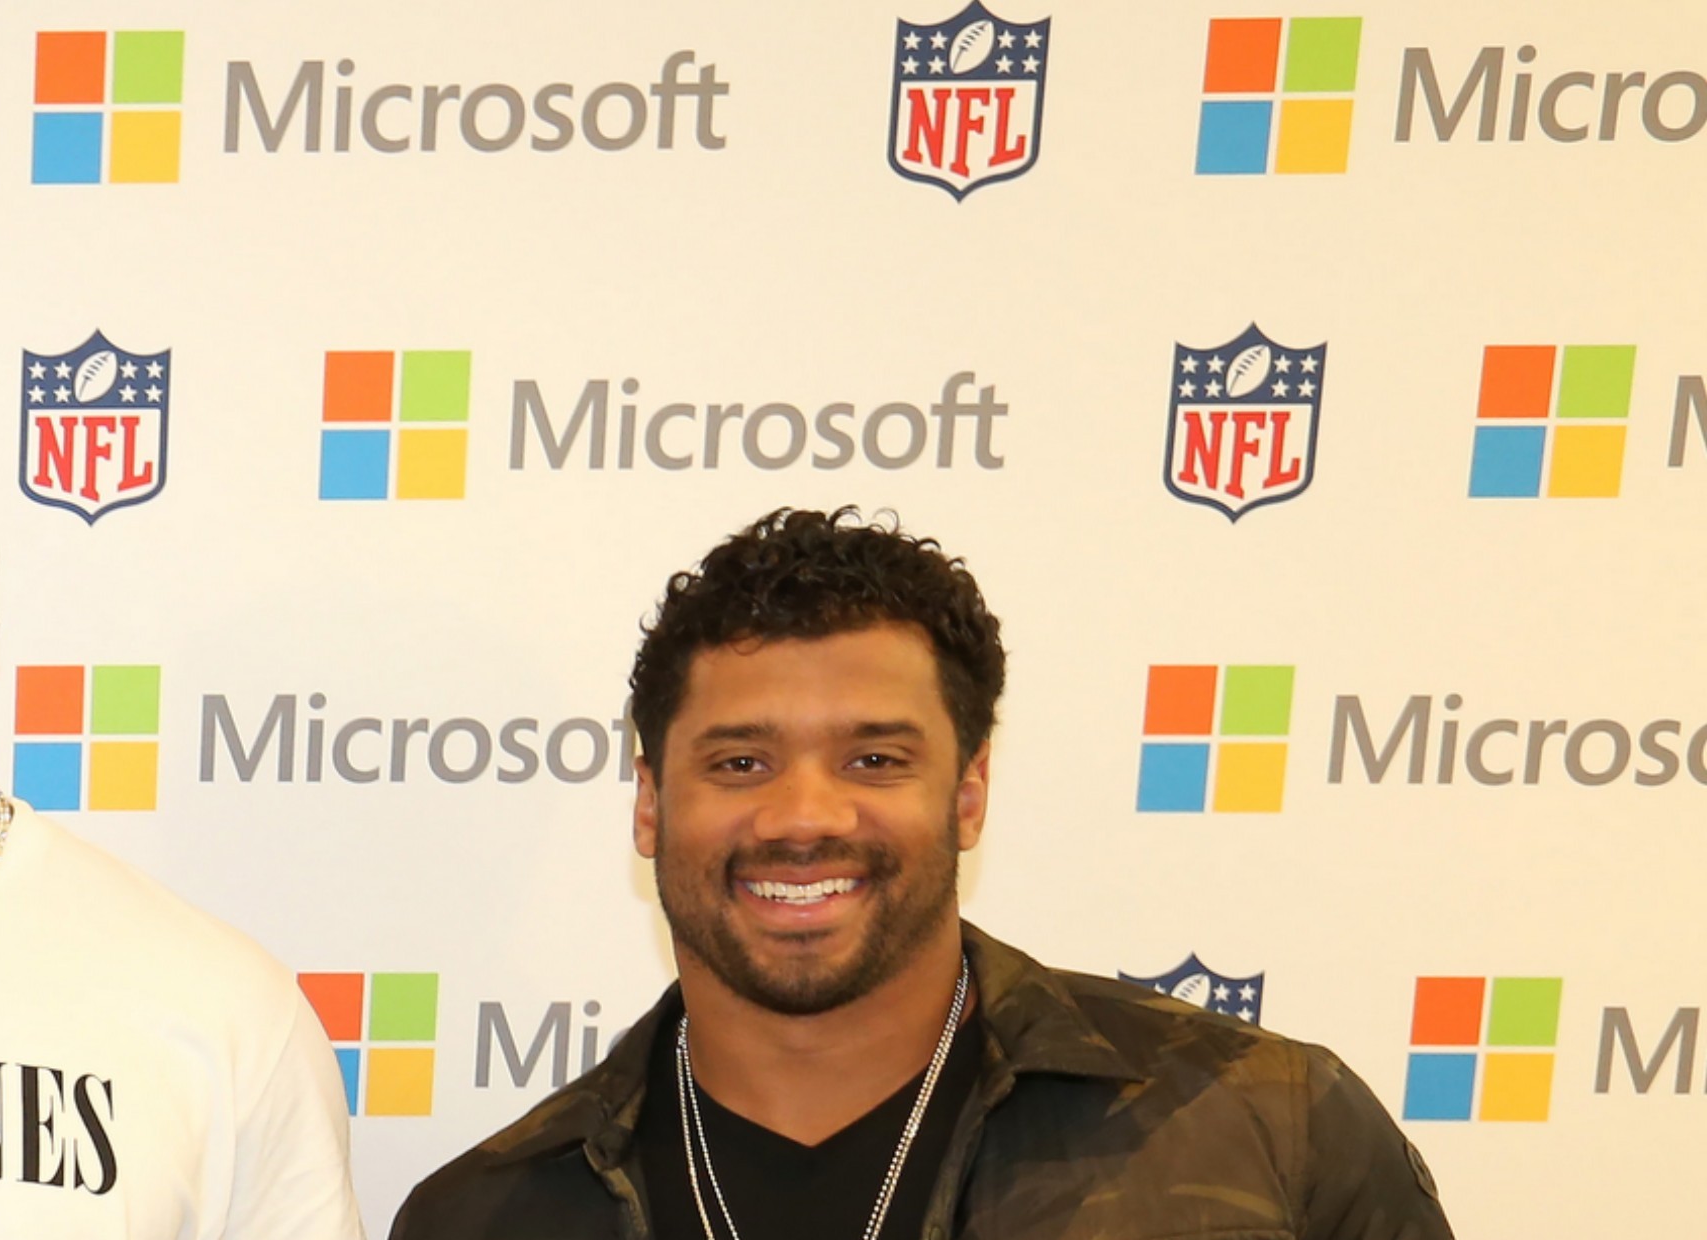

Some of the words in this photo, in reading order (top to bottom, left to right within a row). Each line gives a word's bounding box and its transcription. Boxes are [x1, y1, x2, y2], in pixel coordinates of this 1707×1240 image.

[224, 50, 729, 153] Microsoft
[904, 88, 1025, 176] NFL
[1395, 45, 1707, 142] Micro
[35, 417, 152, 500] NFL
[510, 371, 1008, 470] Microsoft
[1179, 412, 1299, 498] NFL
